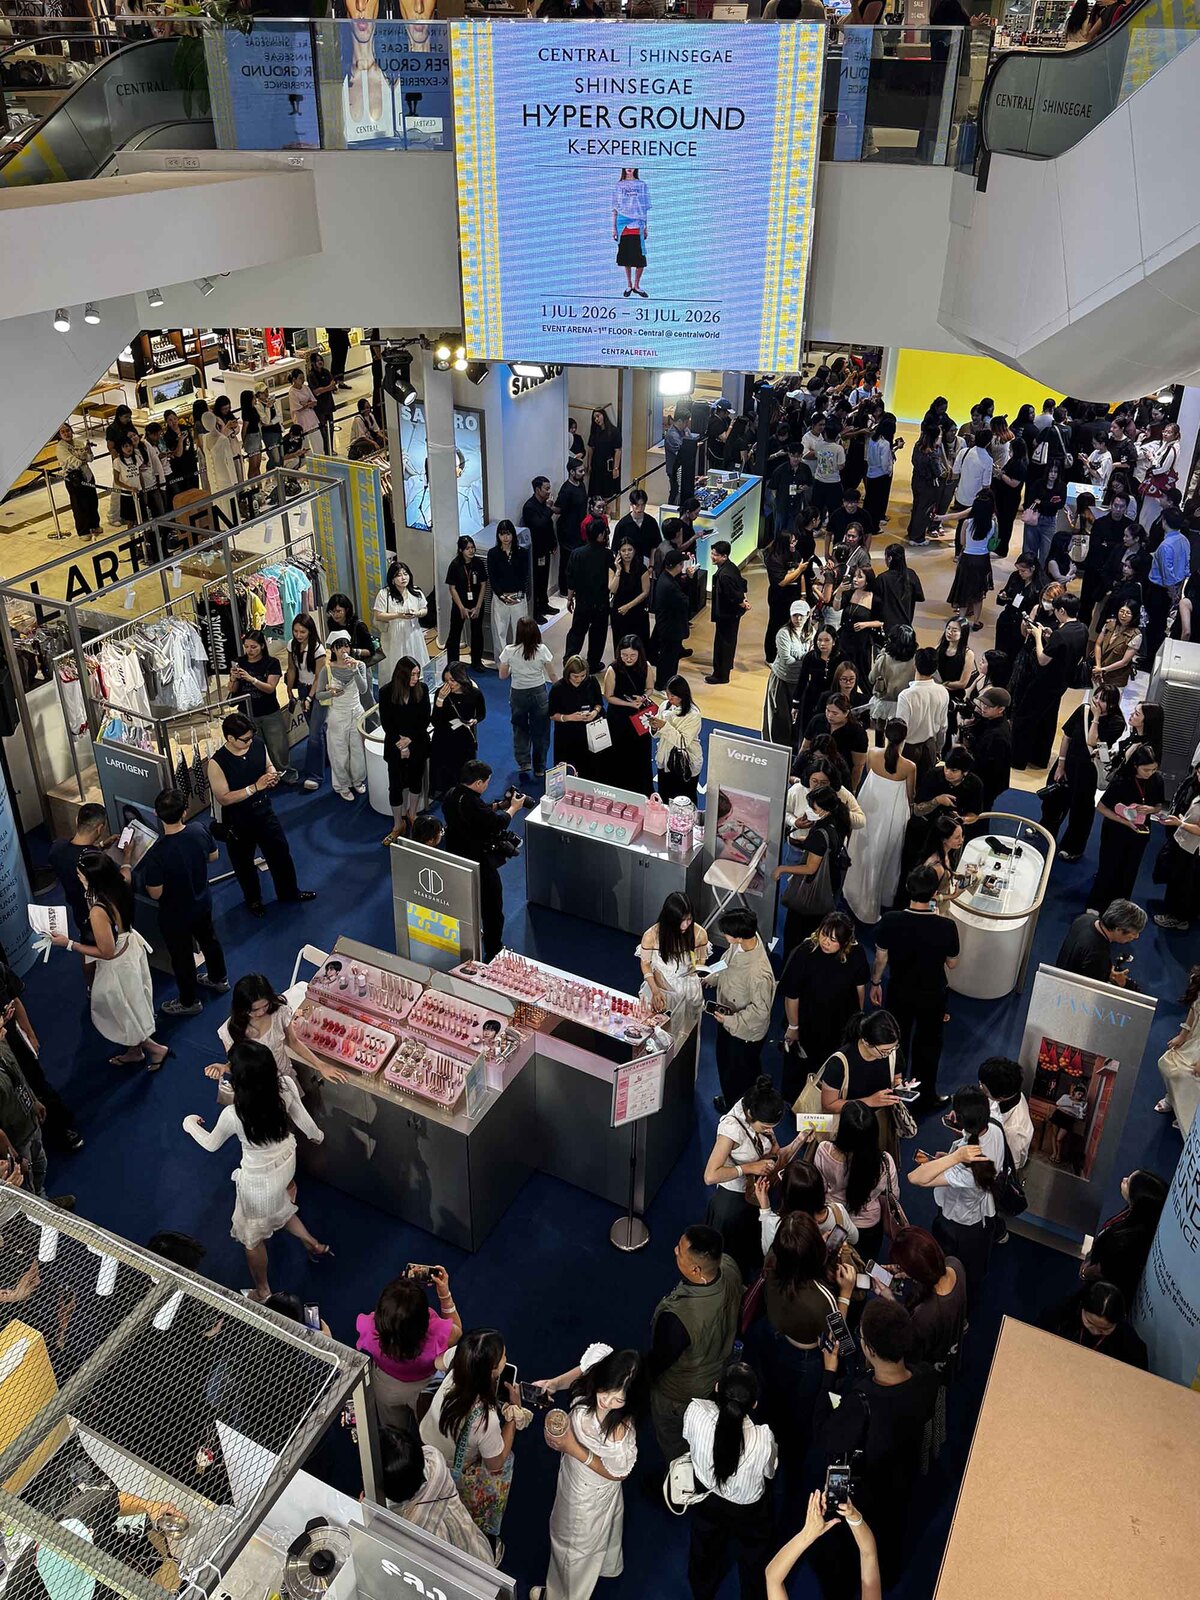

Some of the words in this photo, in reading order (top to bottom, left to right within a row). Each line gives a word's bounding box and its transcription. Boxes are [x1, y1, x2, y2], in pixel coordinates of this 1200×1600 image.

[539, 48, 620, 62] CENTRAL
[640, 49, 733, 63] SHINSEGAE
[116, 80, 168, 96] CENTRAL
[575, 78, 693, 95] SHINSEGAE
[996, 94, 1034, 111] CENTRAL
[1042, 100, 1092, 118] SHINSEGAE
[523, 104, 612, 128] HYPER
[618, 106, 745, 131] GROUND
[568, 138, 697, 157] K-EXPERIENCE
[541, 305, 547, 317] 1
[551, 305, 577, 318] JUL
[582, 306, 616, 319] 2026
[635, 309, 649, 321] 31
[653, 309, 680, 322] JUL
[685, 310, 721, 323] 2026
[567, 326, 592, 334] ARENA
[608, 328, 633, 336] FLOOR
[638, 329, 664, 337] Central
[728, 748, 768, 766] Verries
[105, 756, 149, 778] LARTIGENT
[593, 787, 616, 799] Verries
[413, 889, 450, 907] DEARDAHLIA
